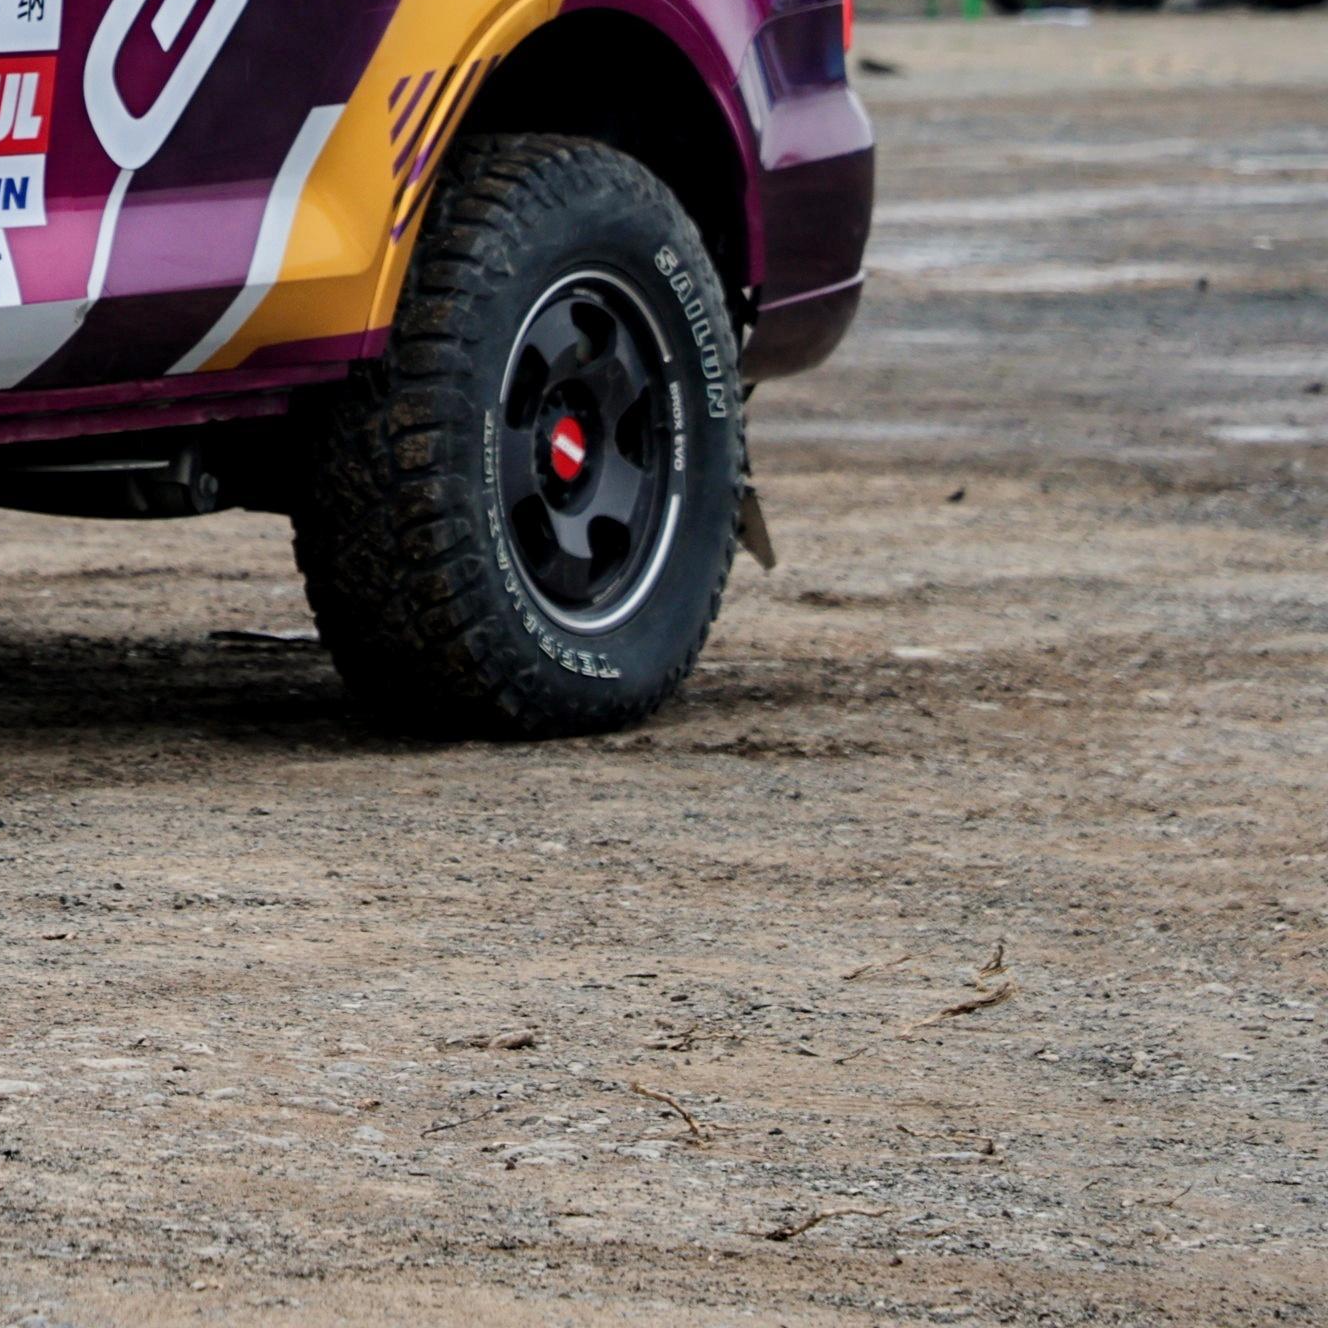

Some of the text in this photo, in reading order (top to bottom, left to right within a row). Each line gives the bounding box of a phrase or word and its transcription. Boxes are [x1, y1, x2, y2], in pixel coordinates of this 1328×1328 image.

[654, 245, 728, 418] SAILUN
[669, 381, 687, 472] BROX EVO
